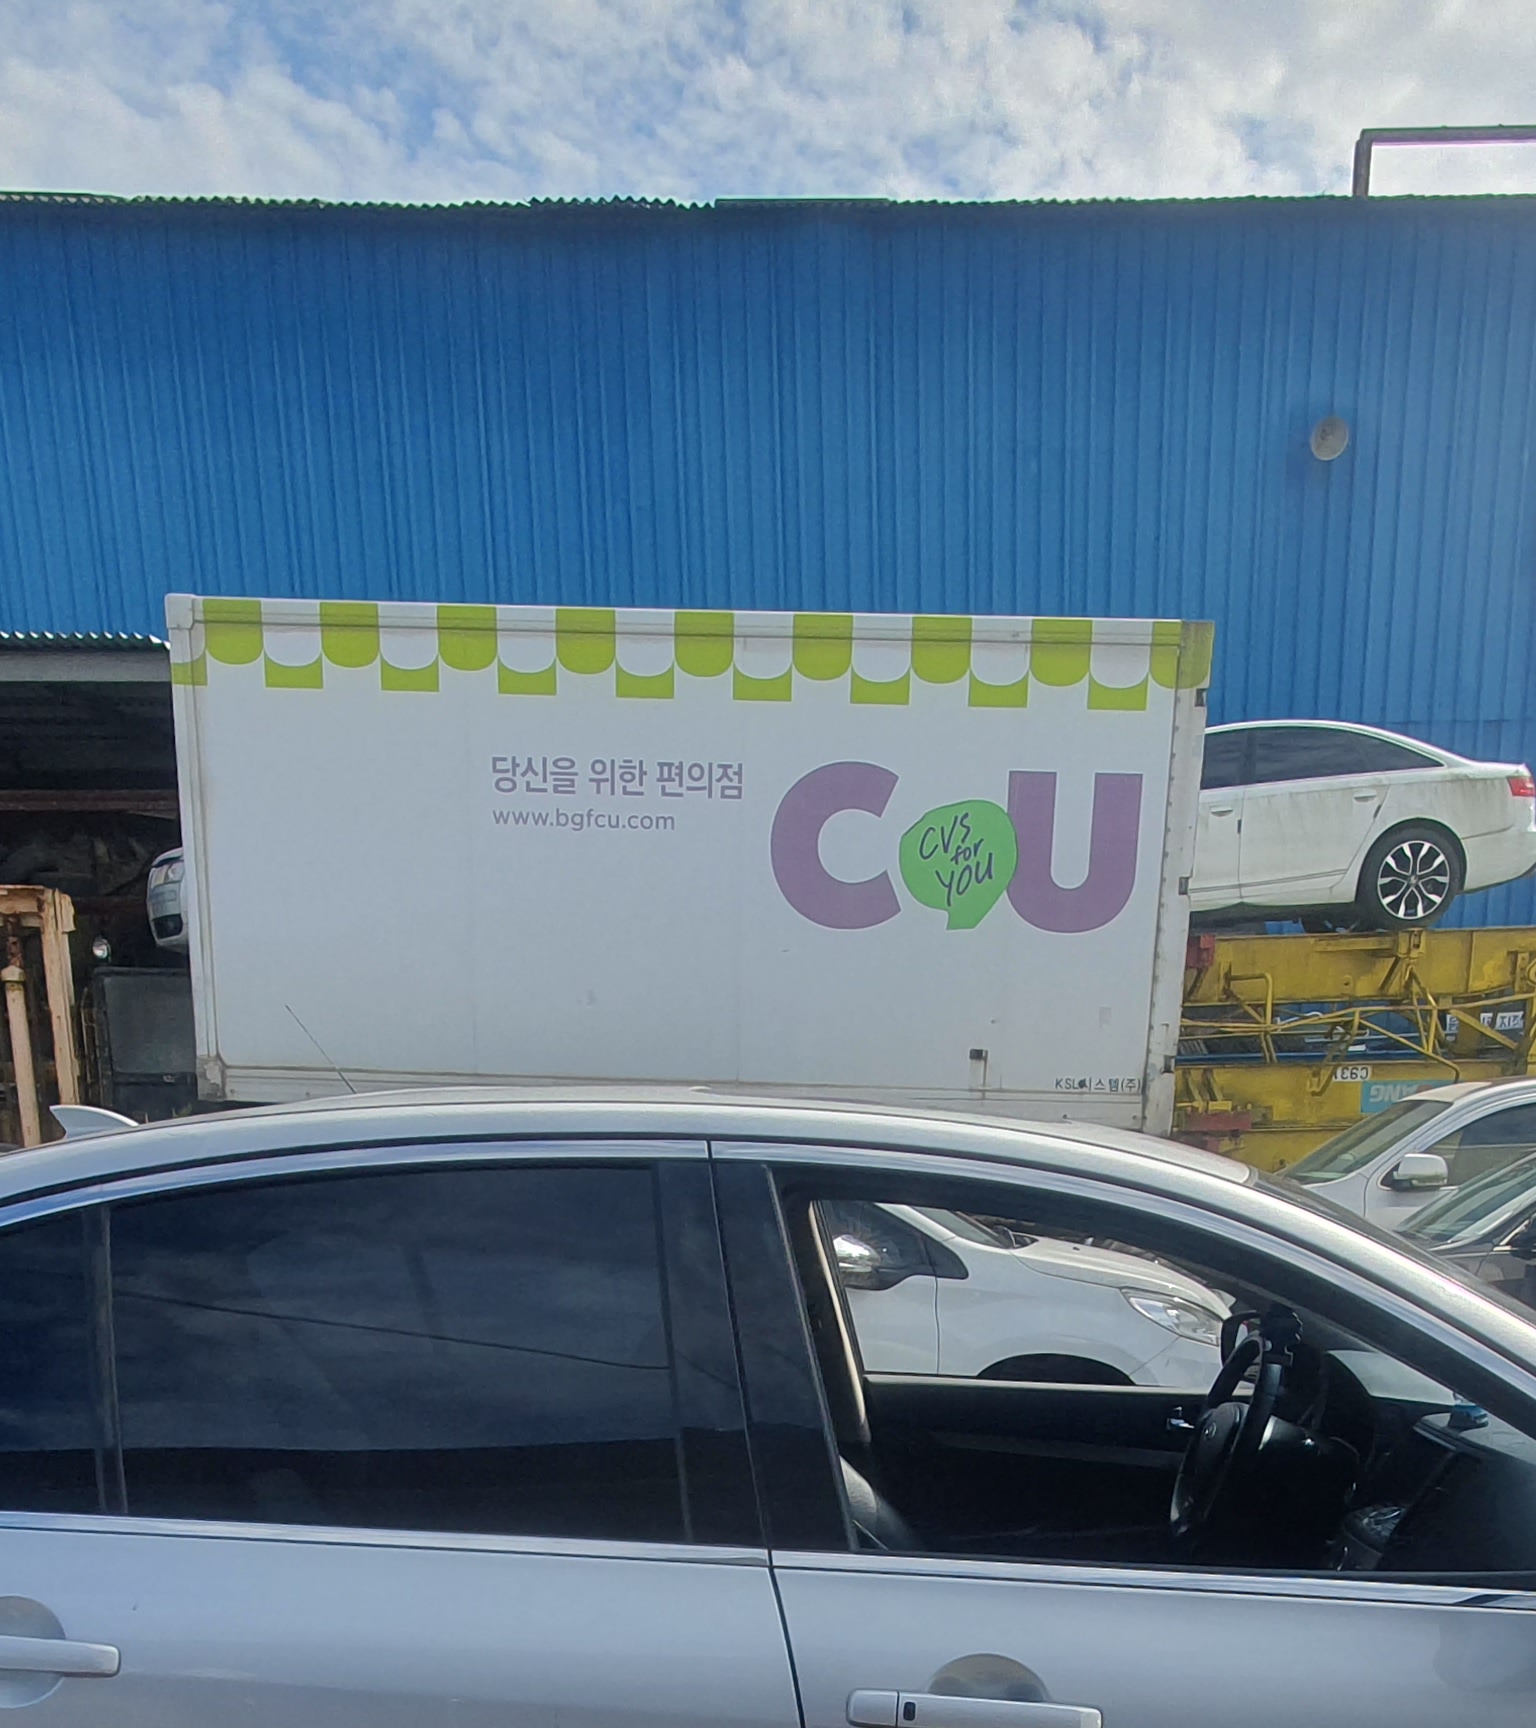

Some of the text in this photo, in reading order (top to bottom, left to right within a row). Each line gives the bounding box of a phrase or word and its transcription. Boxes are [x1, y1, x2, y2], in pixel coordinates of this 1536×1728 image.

[491, 756, 743, 800] 당신을 위한 편의점
[492, 808, 675, 831] www.bgfcu.com
[919, 812, 971, 860] CVS
[950, 838, 984, 865] for
[934, 852, 993, 907] YOU
